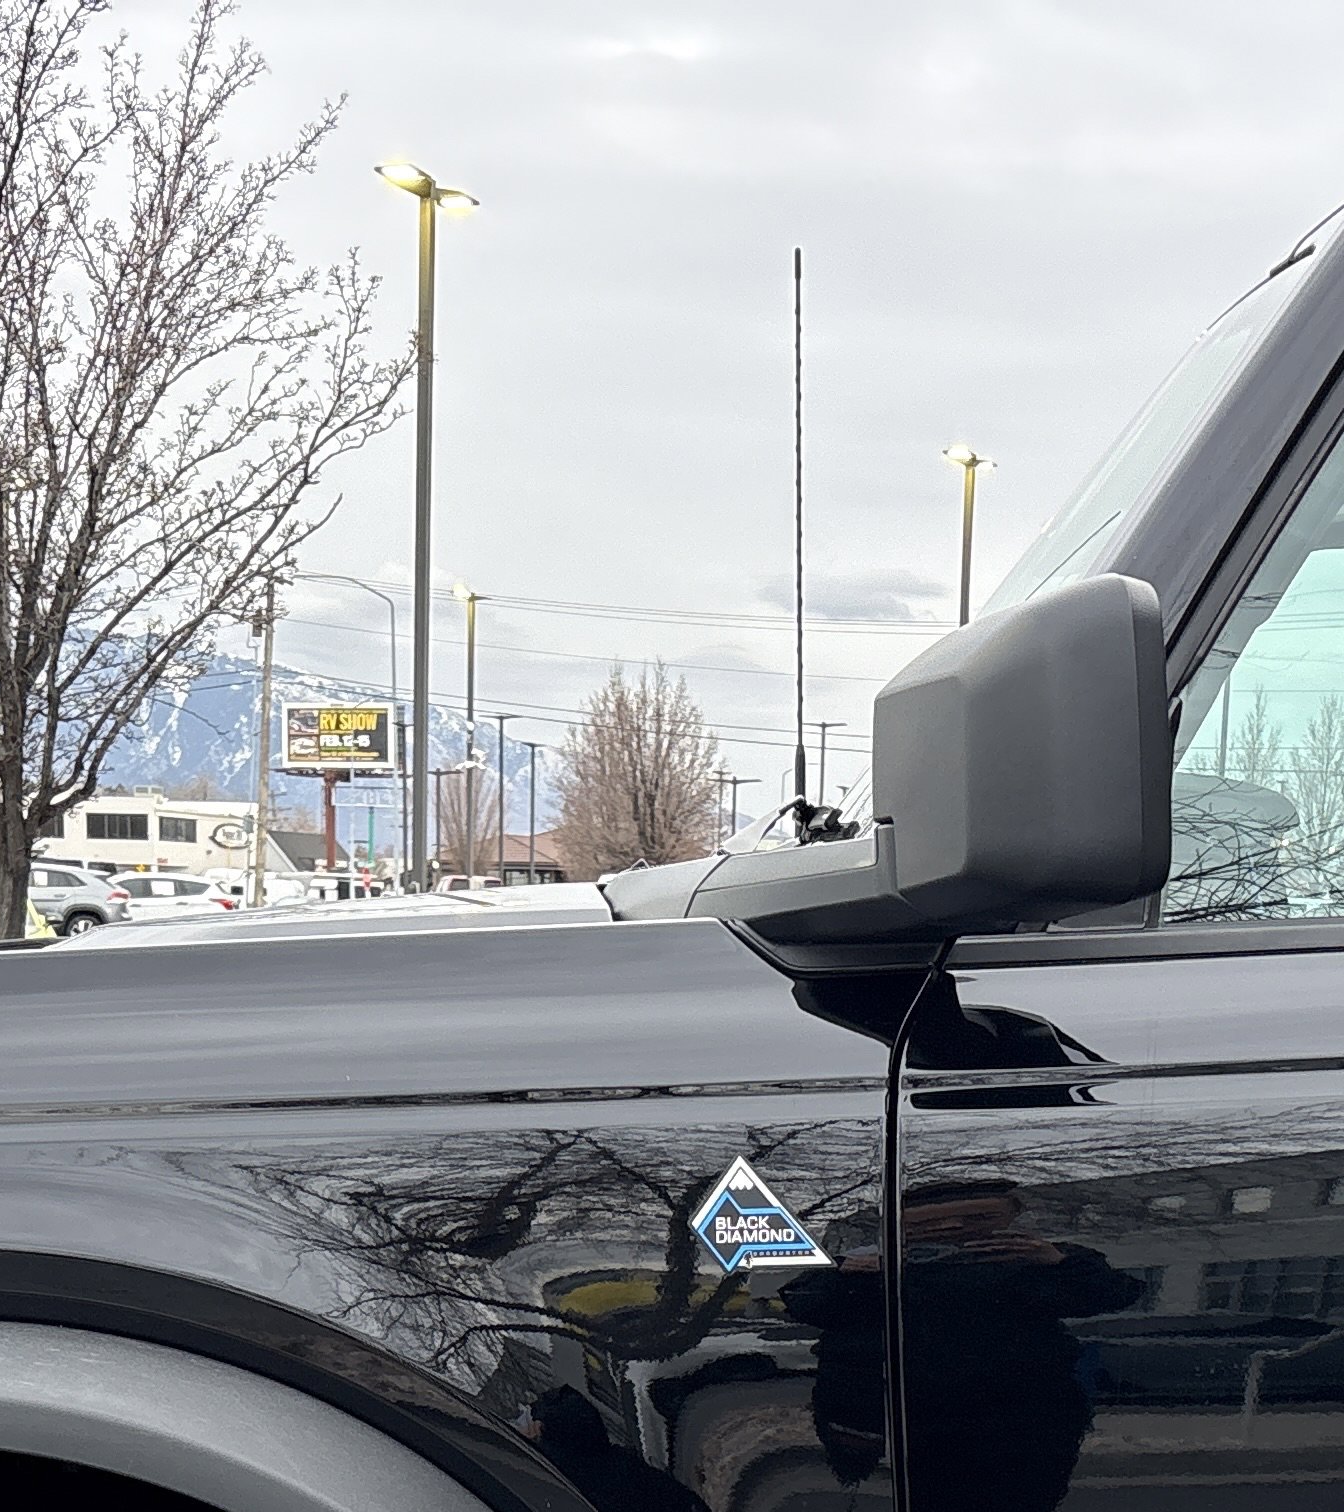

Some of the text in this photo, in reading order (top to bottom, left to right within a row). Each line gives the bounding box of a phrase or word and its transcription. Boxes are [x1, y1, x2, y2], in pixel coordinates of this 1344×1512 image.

[320, 713, 378, 731] RV SHOW
[715, 1215, 770, 1230] BLACK
[715, 1228, 795, 1244] DIAMOND
